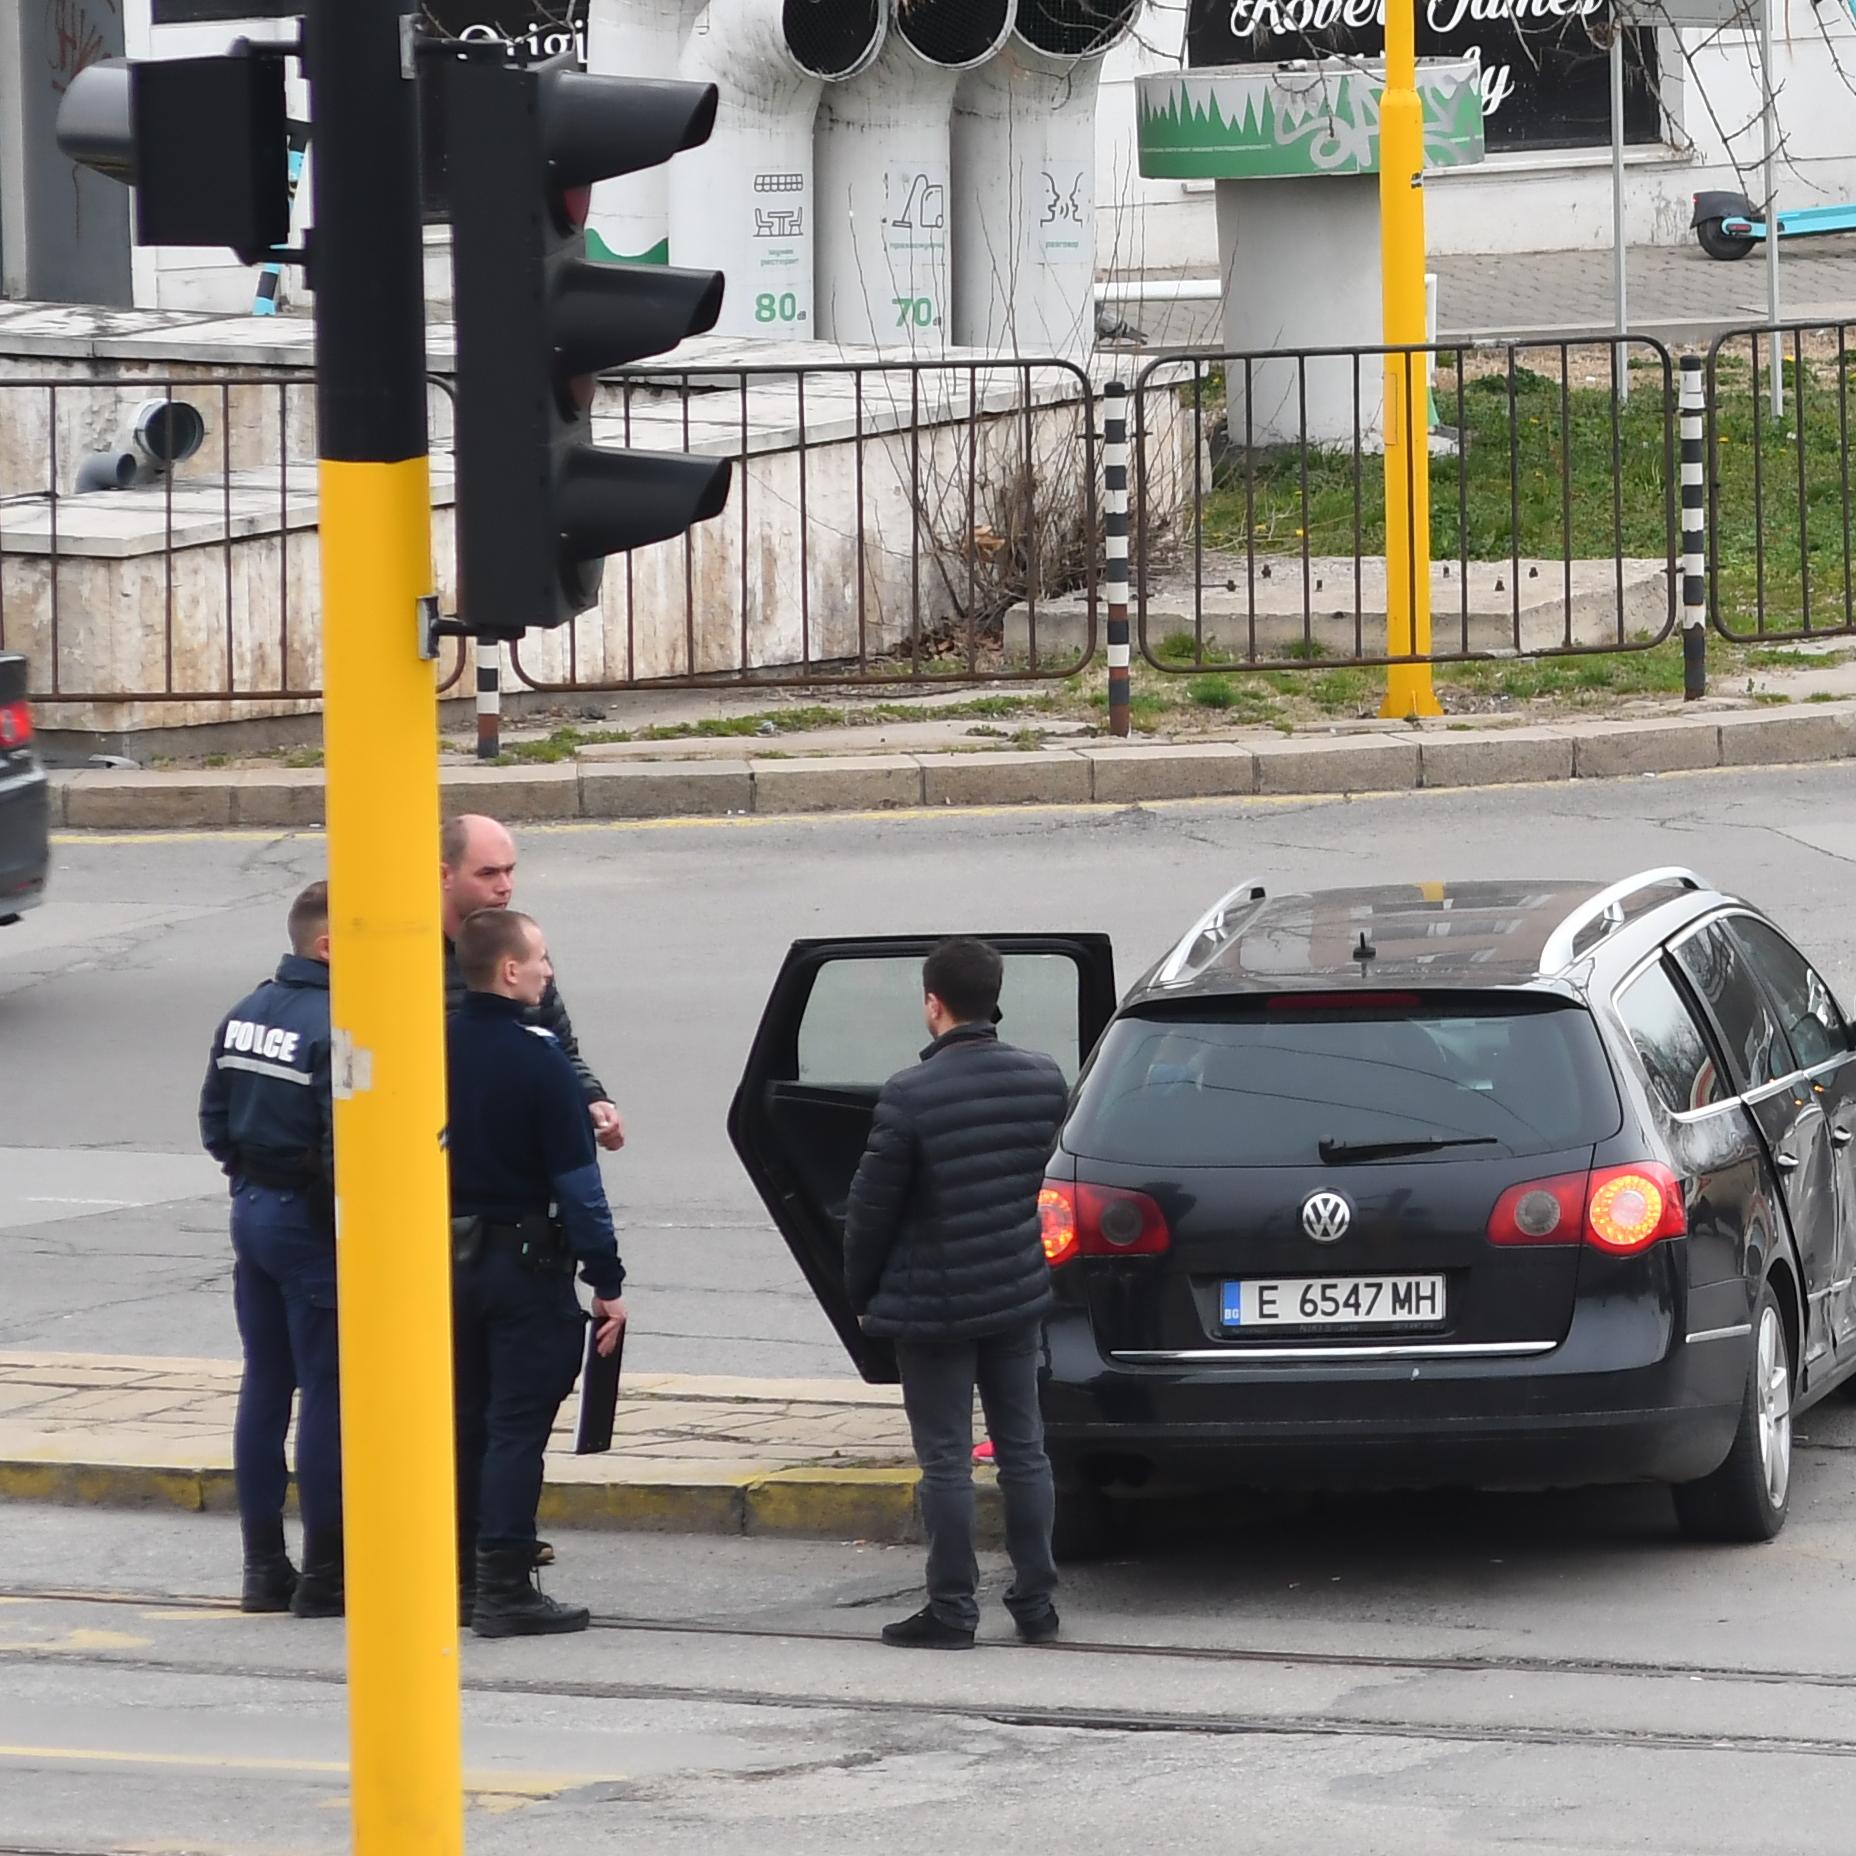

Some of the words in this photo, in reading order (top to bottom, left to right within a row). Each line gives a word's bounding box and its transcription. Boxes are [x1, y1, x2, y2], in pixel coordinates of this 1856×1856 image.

[755, 292, 796, 322] 80
[892, 297, 932, 327] 70
[1224, 1308, 1240, 1320] BG
[1258, 1285, 1280, 1319] E
[1300, 1283, 1383, 1318] 6547
[1391, 1281, 1437, 1316] MH
